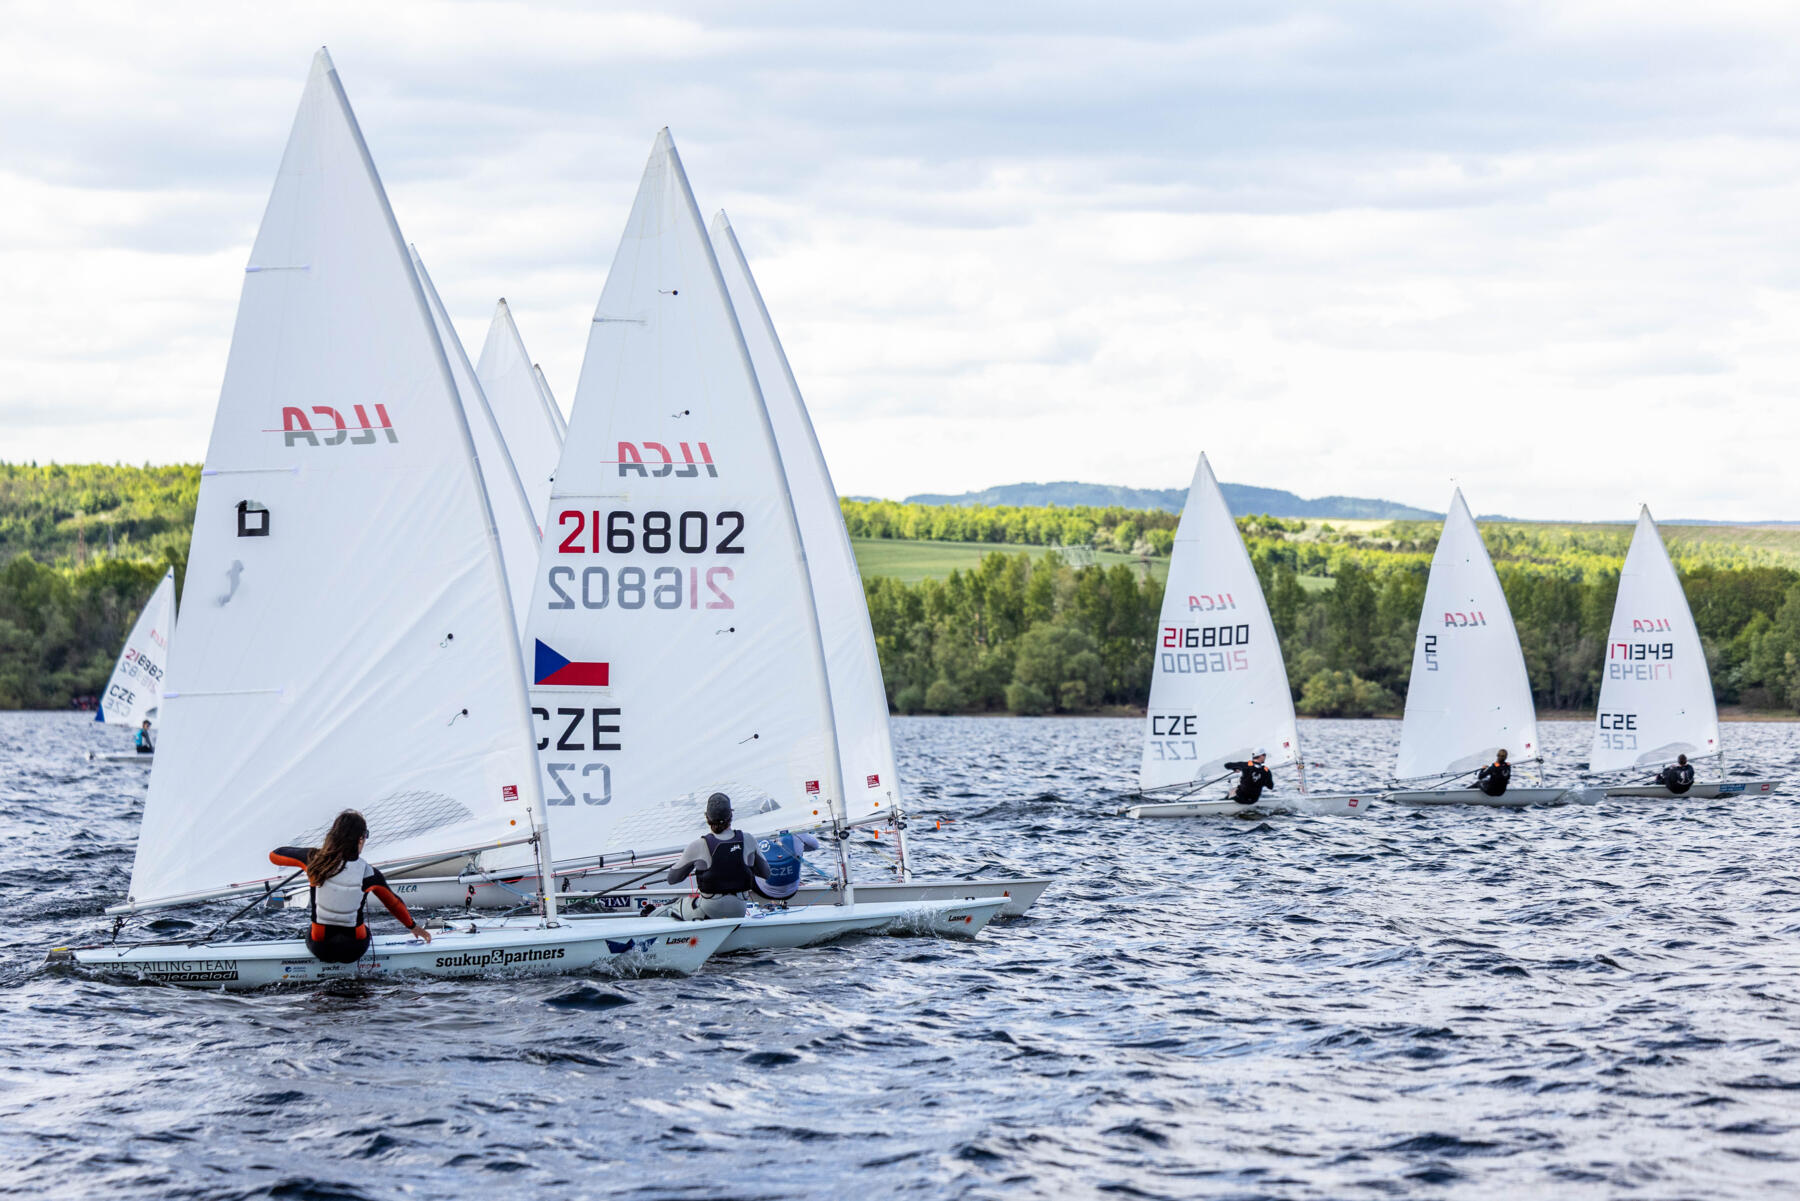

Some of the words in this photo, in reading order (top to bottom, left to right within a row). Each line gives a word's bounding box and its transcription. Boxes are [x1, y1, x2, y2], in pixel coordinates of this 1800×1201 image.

[558, 510, 745, 554] 216802
[1163, 624, 1250, 648] 216800
[1611, 643, 1673, 660] 171349
[110, 684, 136, 705] CZE
[1153, 715, 1198, 736] CZE
[770, 866, 794, 876] CZE
[397, 884, 417, 893] ILCA
[665, 937, 690, 945] Laser
[134, 960, 192, 972] SAILING
[199, 960, 237, 971] TEAM
[435, 948, 565, 968] soukup&partners
